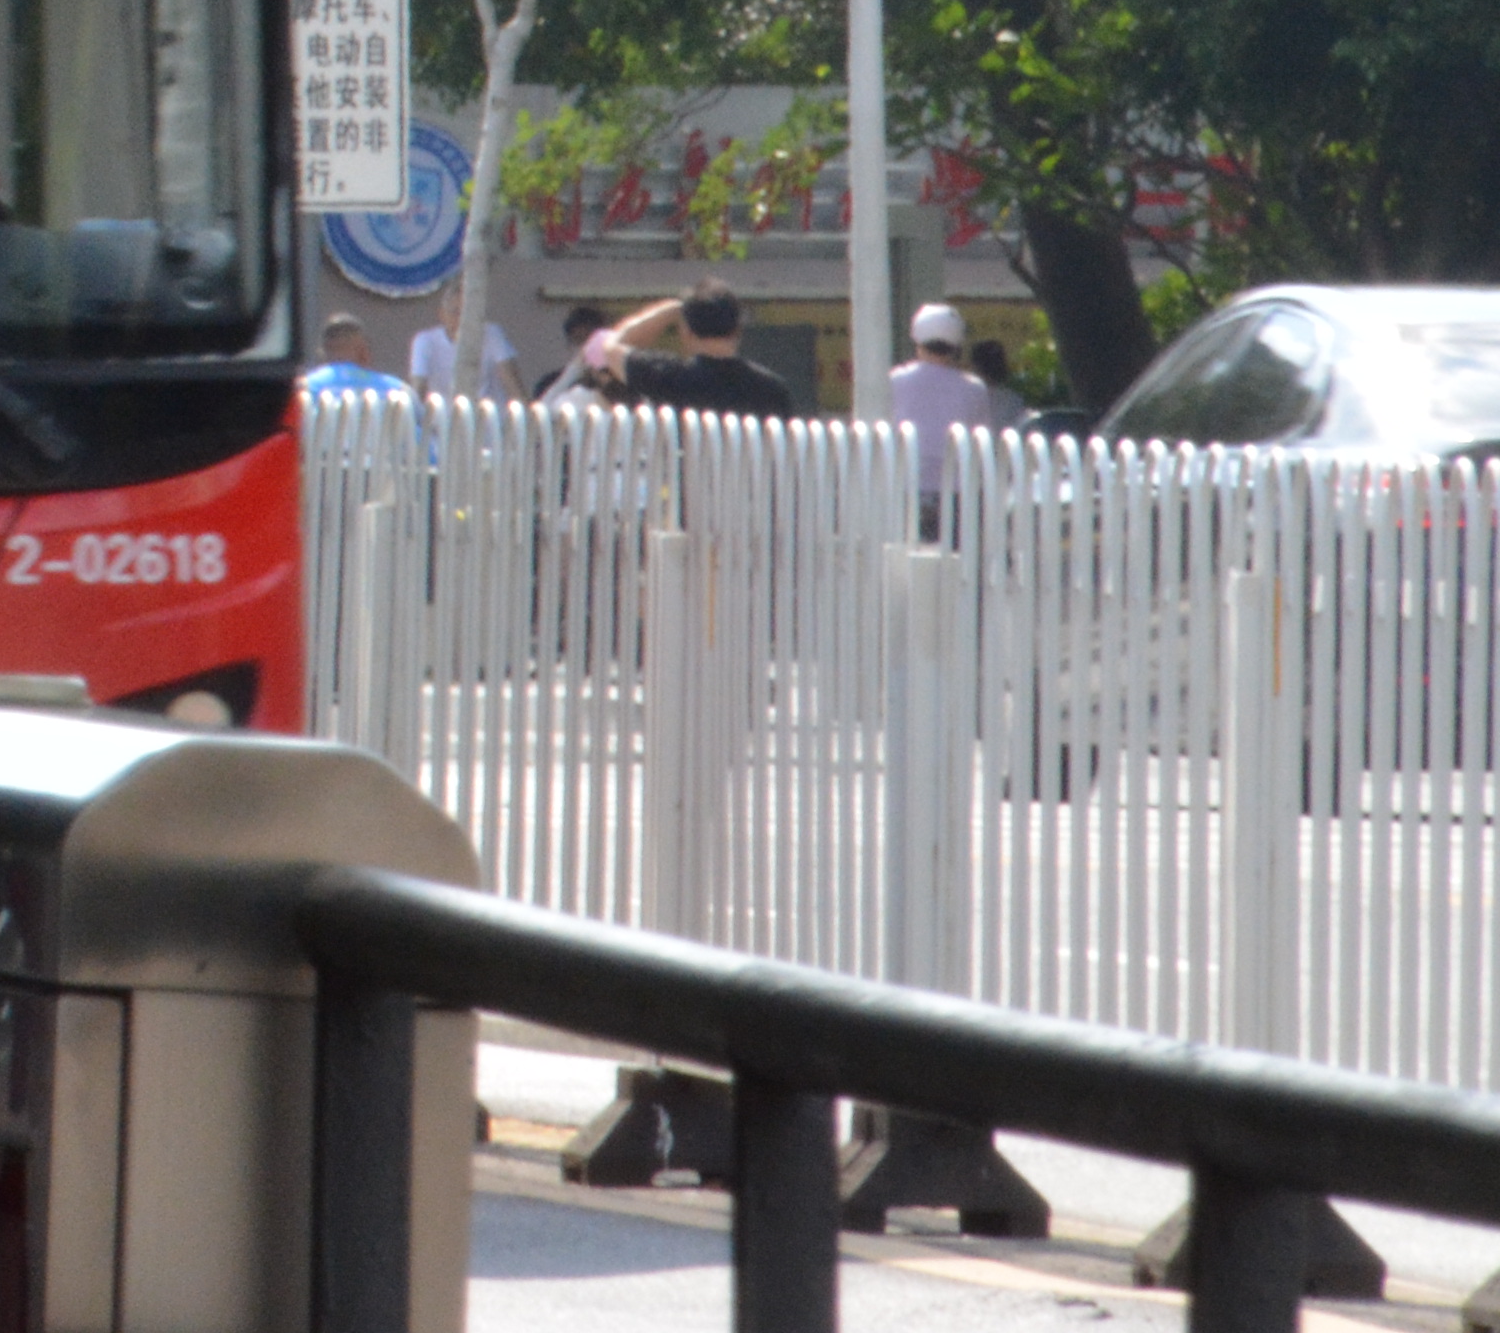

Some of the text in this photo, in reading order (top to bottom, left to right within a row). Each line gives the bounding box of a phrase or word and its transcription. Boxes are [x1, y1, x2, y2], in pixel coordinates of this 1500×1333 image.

[306, 32, 387, 68] 电动自
[297, 74, 389, 110] 他安装
[297, 117, 389, 153] 置的非
[4, 532, 228, 586] 2-02618
